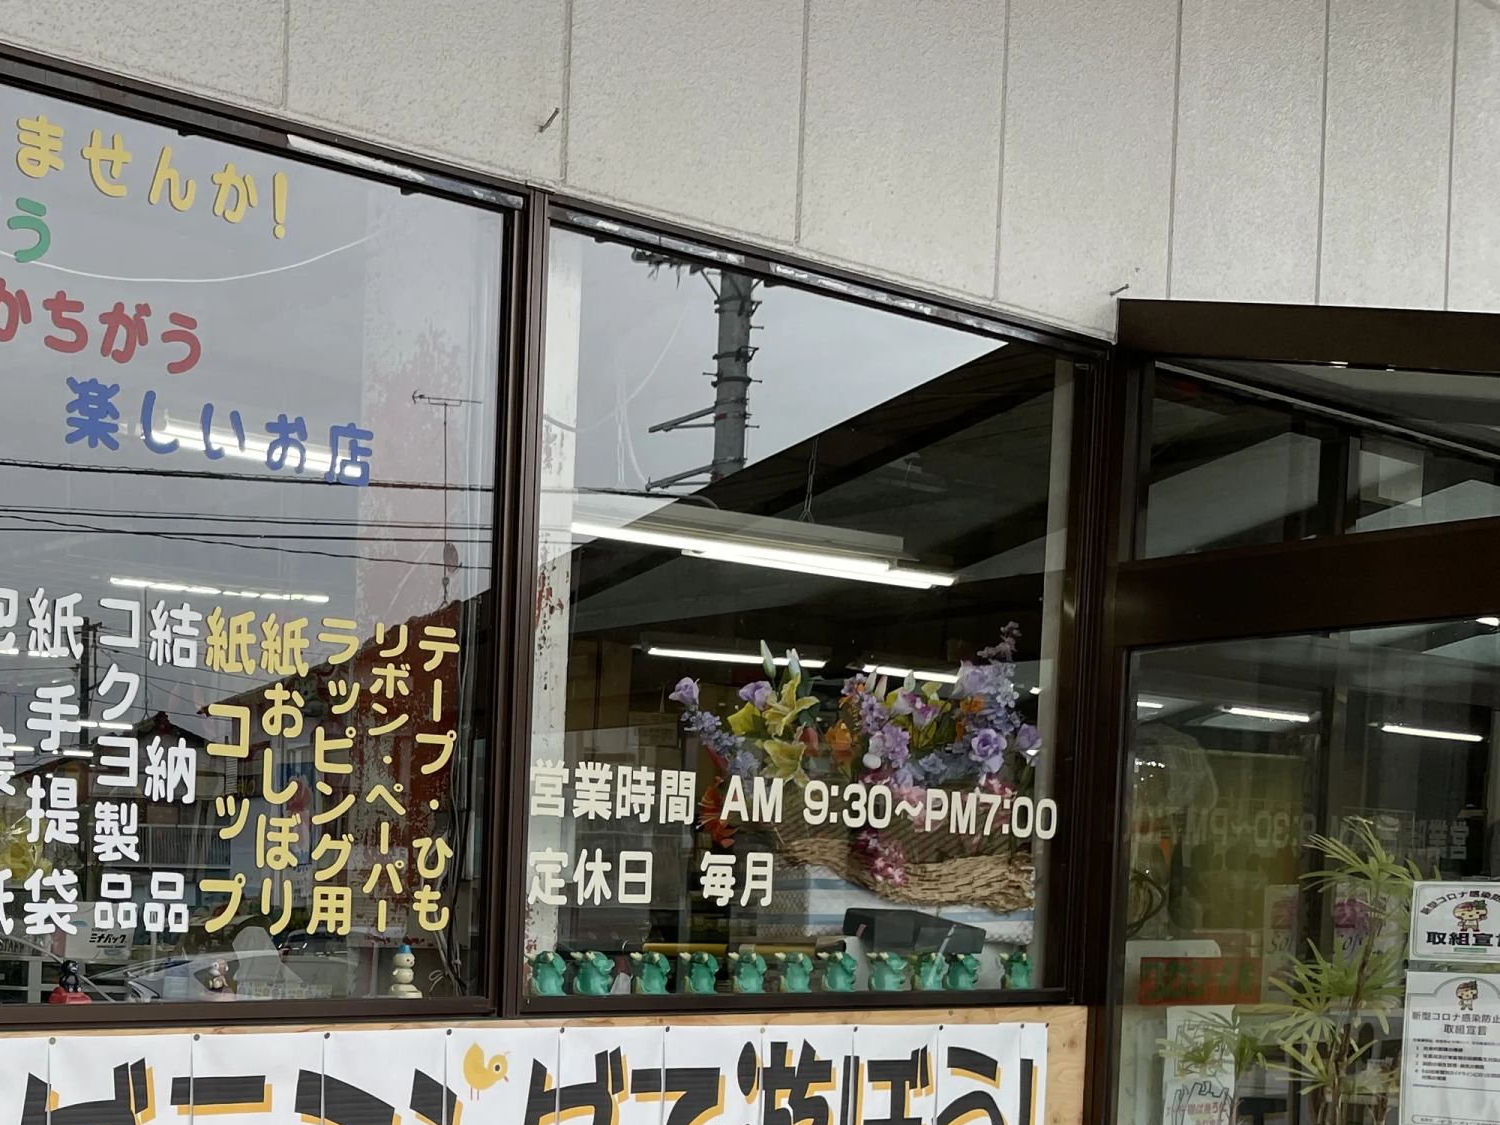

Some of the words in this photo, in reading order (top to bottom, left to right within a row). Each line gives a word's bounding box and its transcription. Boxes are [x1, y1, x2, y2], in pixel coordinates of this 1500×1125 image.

[64, 376, 375, 488] 楽しいお店
[23, 586, 85, 937] 紙手提袋
[92, 596, 141, 934] コクヨ製品
[143, 598, 203, 934] 結納品
[199, 605, 257, 934] 紙コップ
[255, 612, 310, 936] 紙おしぼり
[306, 616, 359, 936] ラッピング用
[411, 624, 461, 932] テープ・ひも
[526, 847, 655, 908] 定休日
[699, 850, 775, 908] 毎月
[528, 758, 697, 826] 営業時間
[719, 776, 784, 825] AM
